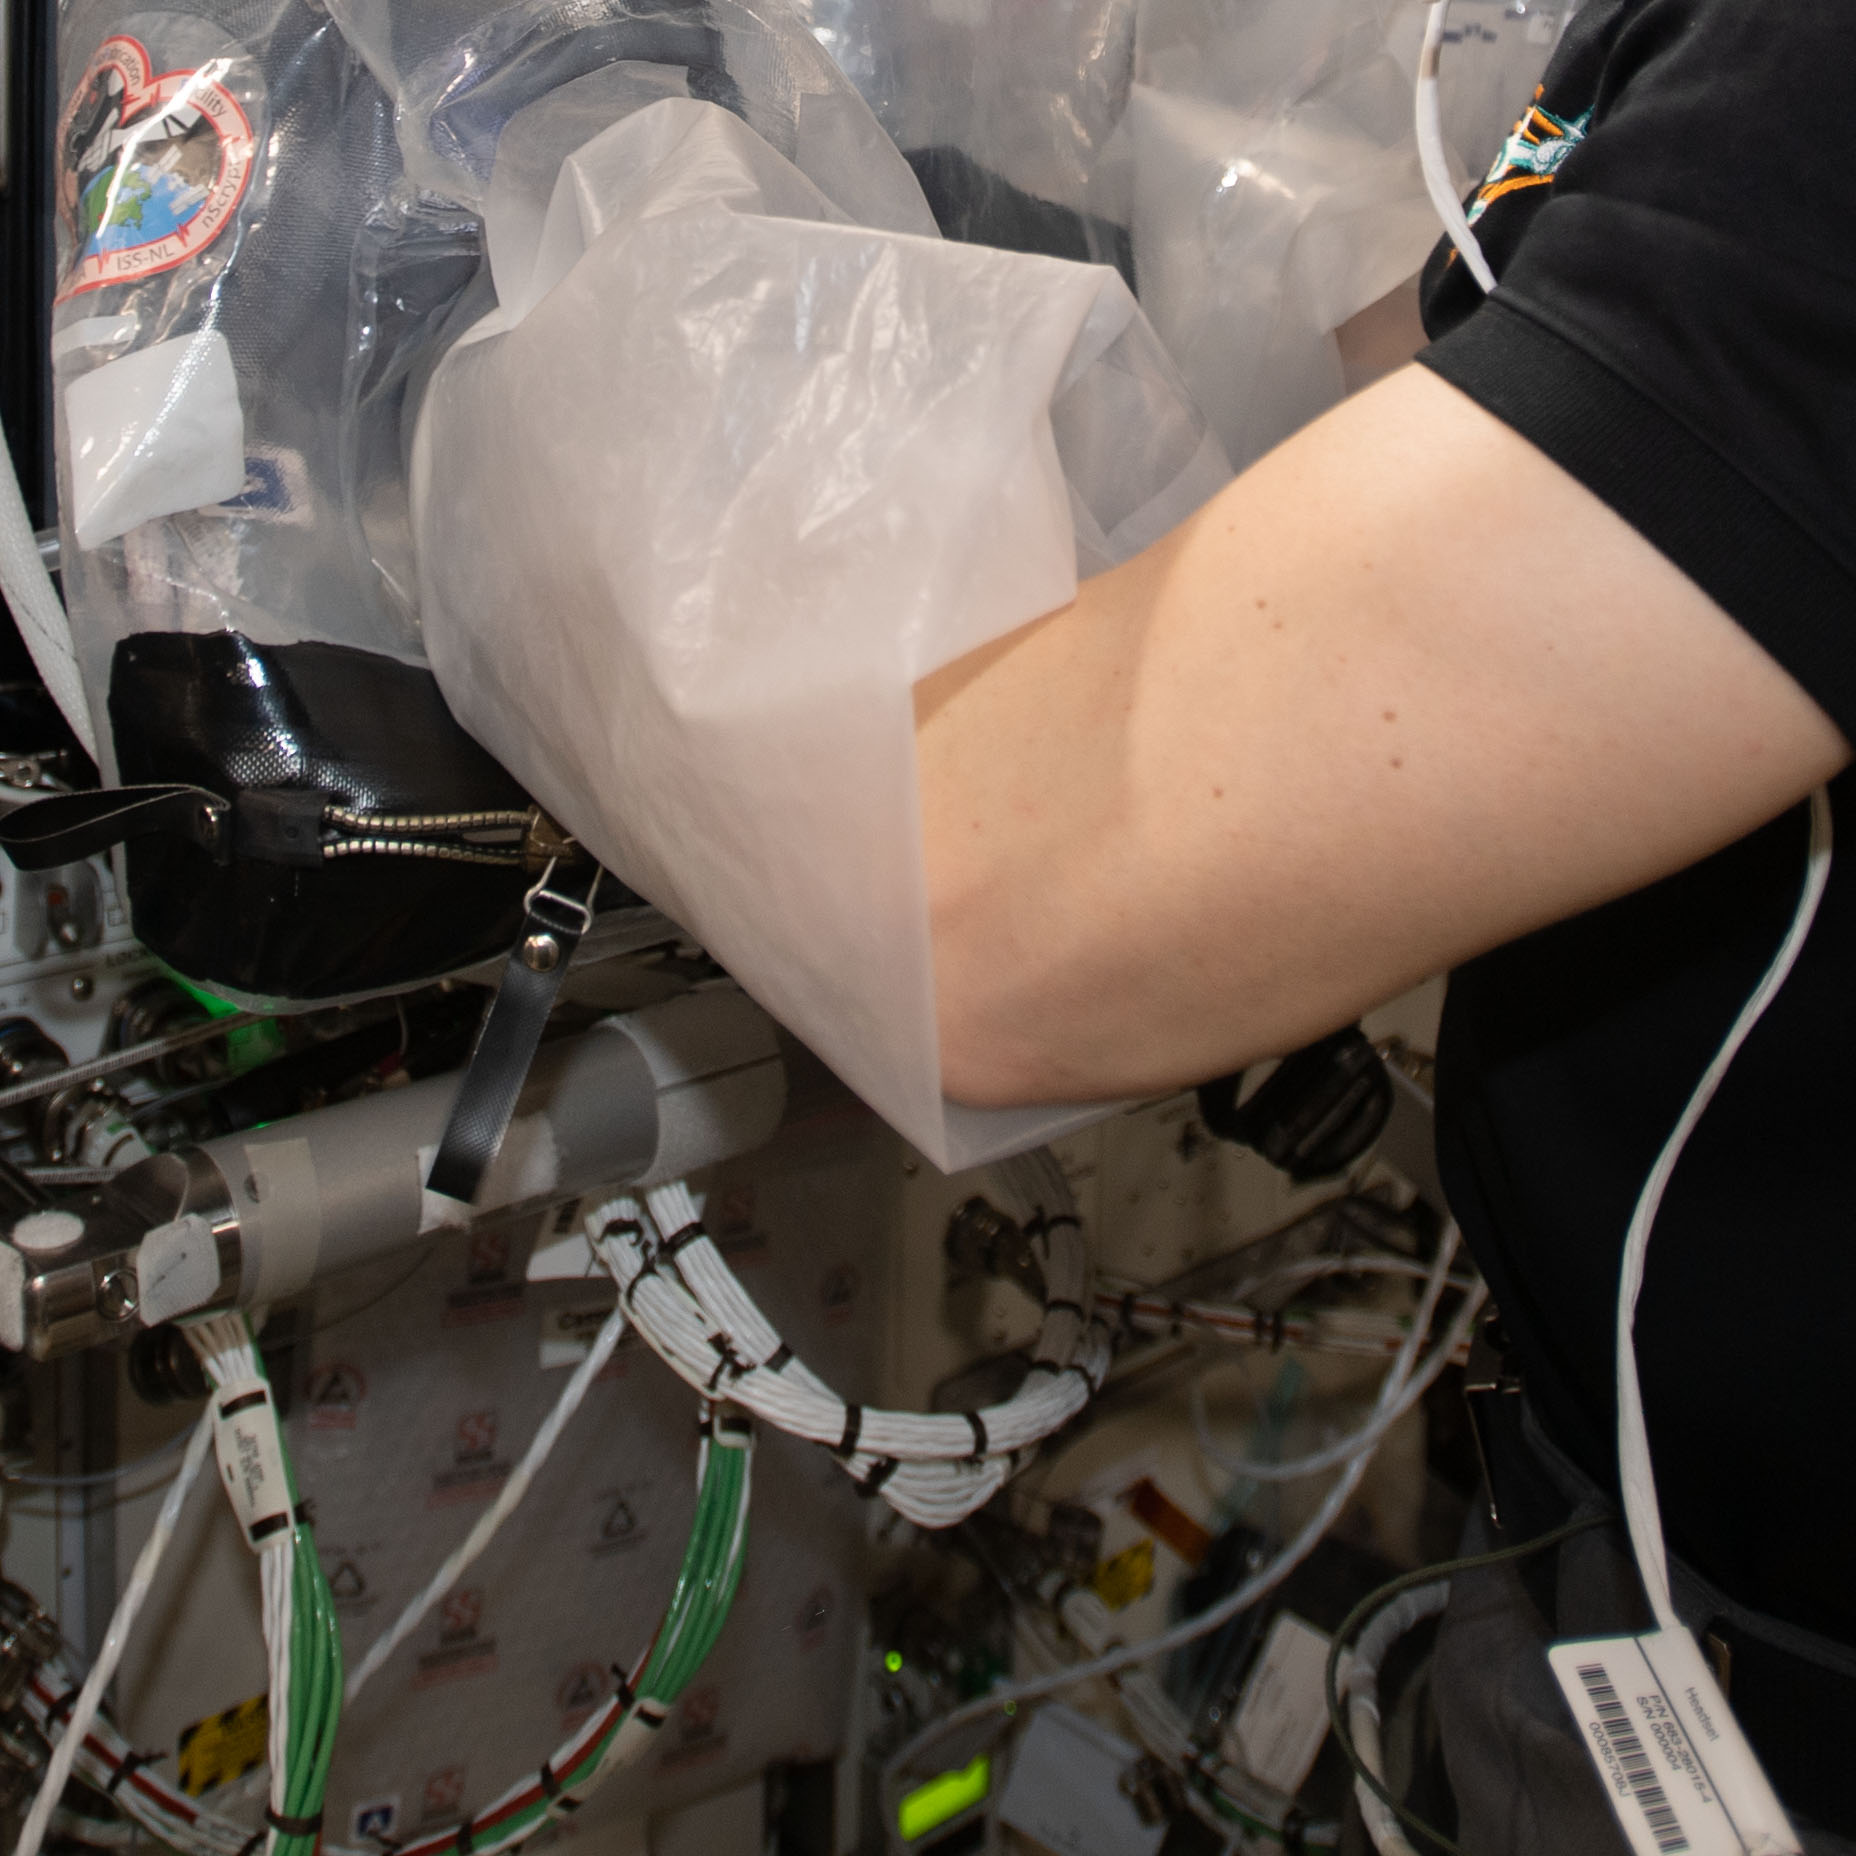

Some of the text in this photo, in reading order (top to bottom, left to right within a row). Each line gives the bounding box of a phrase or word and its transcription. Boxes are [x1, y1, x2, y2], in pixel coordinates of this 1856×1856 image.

[116, 243, 175, 271] ISS-NL
[1636, 1695, 1656, 1720] S/N
[1648, 1694, 1669, 1718] P/N
[1685, 1686, 1721, 1742] Headset
